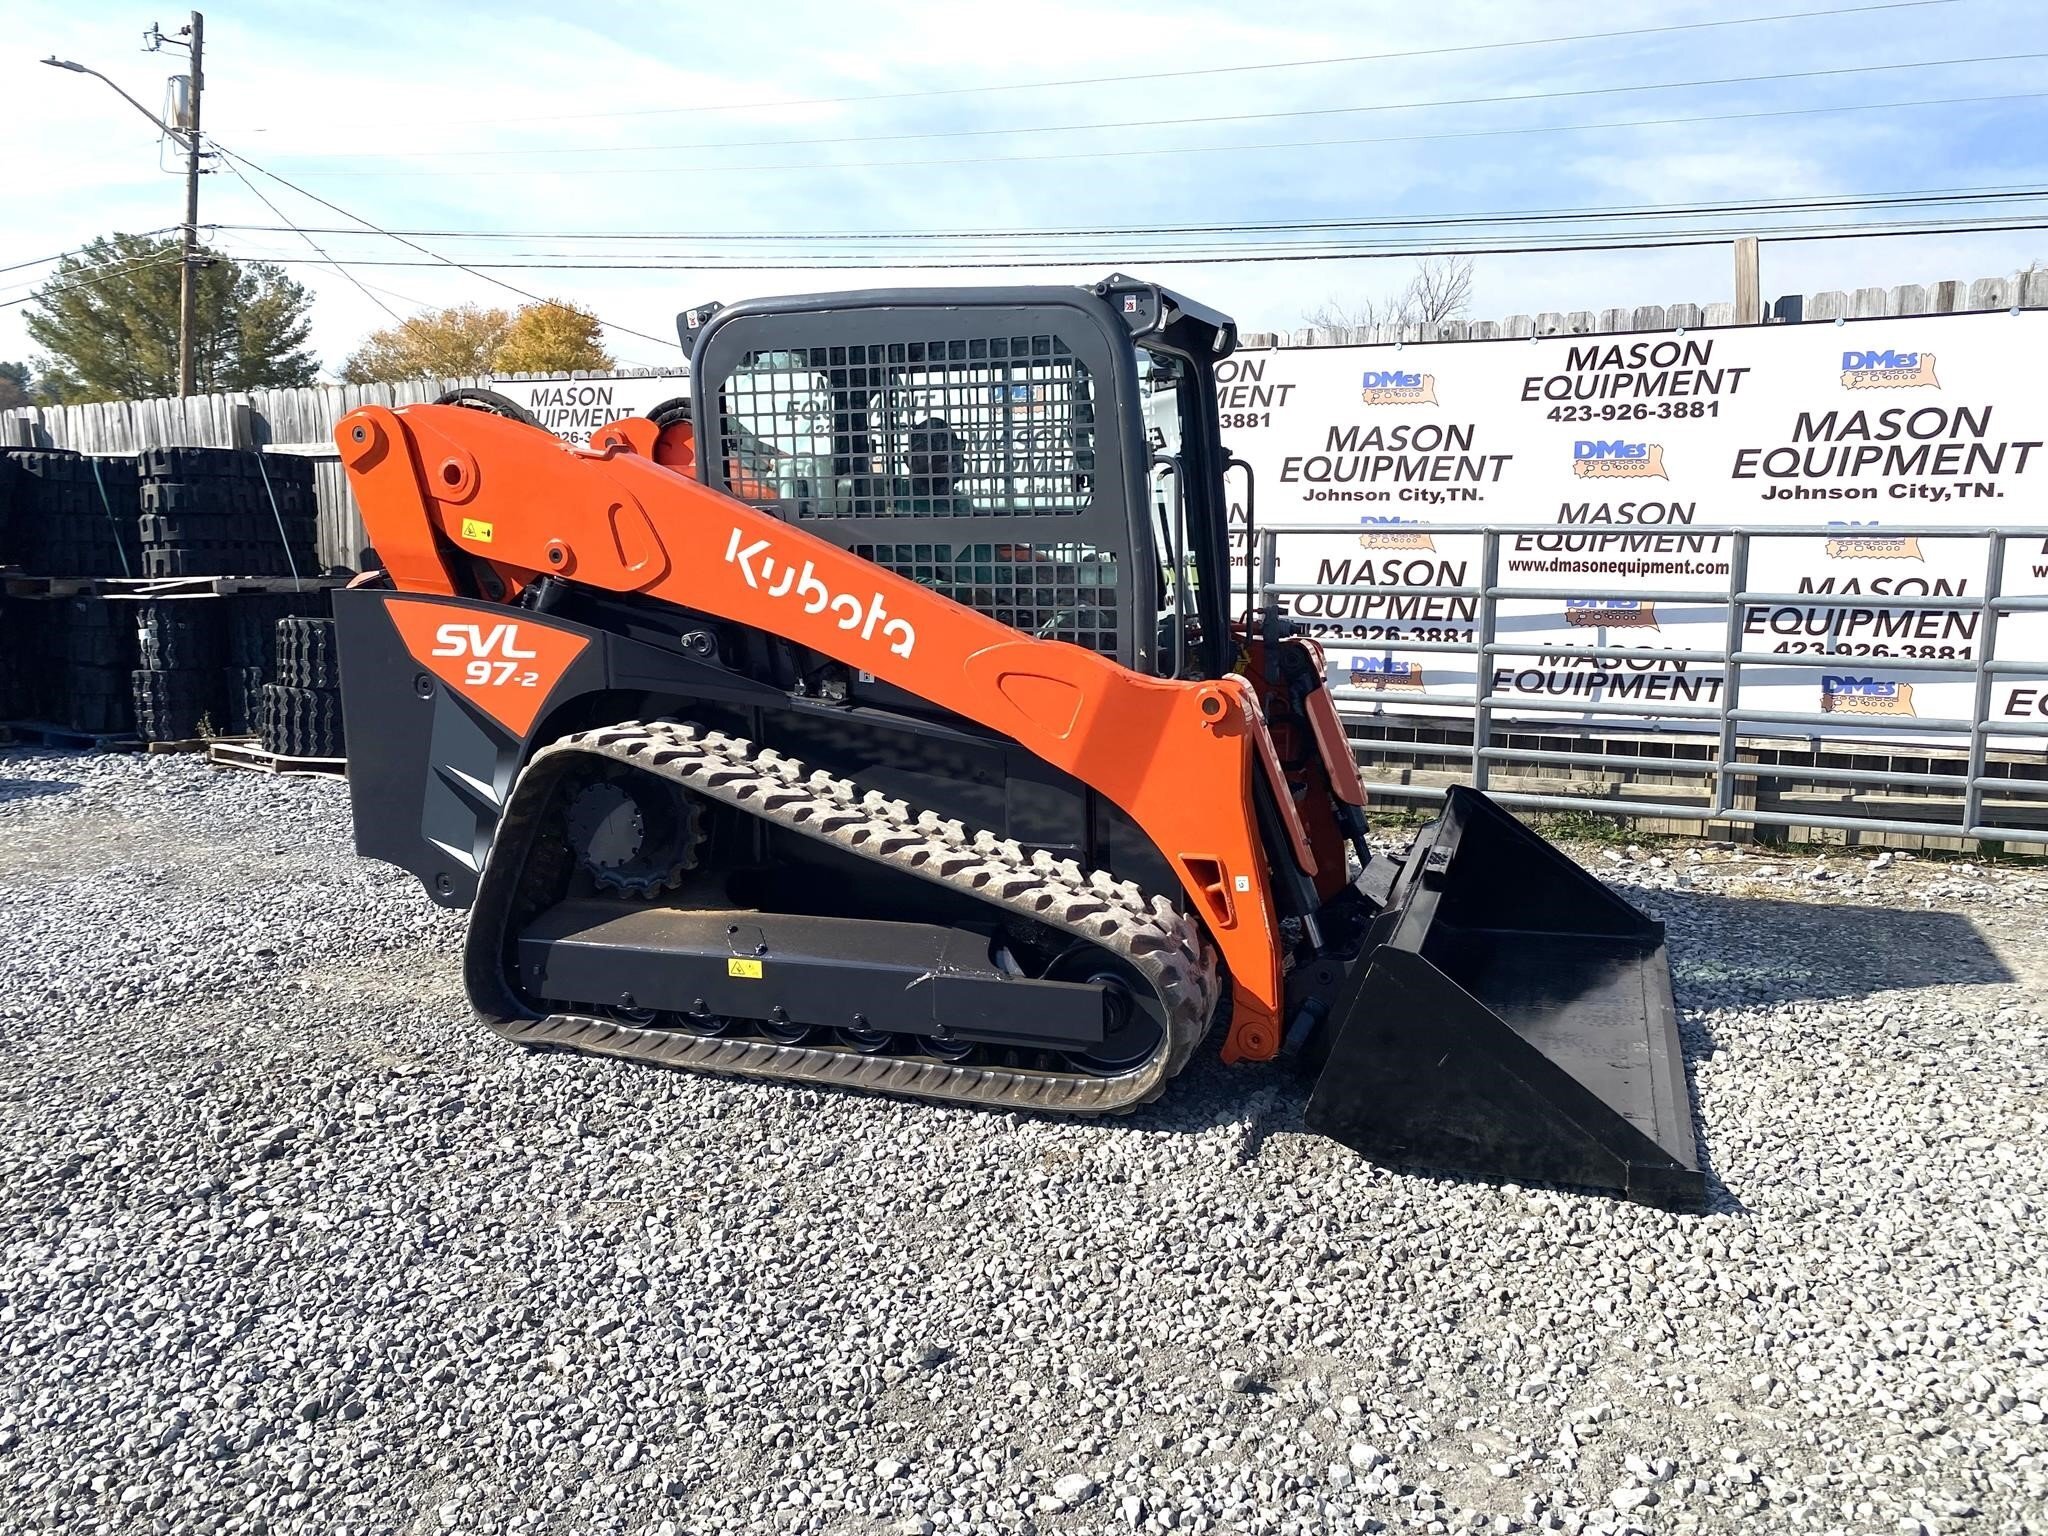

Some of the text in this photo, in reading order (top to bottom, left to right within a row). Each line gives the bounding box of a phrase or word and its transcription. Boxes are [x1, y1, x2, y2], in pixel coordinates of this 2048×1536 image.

[1566, 339, 1714, 371] MASON
[531, 387, 613, 407] MASON
[1521, 367, 1751, 402] EQUIPMENT
[1547, 401, 1720, 422] 423-926-3881
[1792, 405, 1993, 443] MASON
[1326, 424, 1475, 452] MASON
[1280, 455, 1513, 482] EQUIPMENT
[1732, 441, 2044, 479] EQUIPMENT
[1302, 487, 1484, 505] Johnson City,TN.
[1761, 482, 2005, 502] Johnson City,TN.
[1557, 502, 1696, 525] MASON
[1514, 534, 1722, 553] EQUIPMENT
[1317, 559, 1467, 586] MASON
[1508, 557, 1730, 577] www.dmasonequipment.com
[724, 527, 916, 659] Kubota
[1798, 576, 1967, 597] MASON
[431, 624, 536, 659] SVL
[1773, 641, 1972, 660] 423-926-3881
[465, 660, 537, 688] 97-2
[1492, 668, 1725, 703] EQUIPMENT
